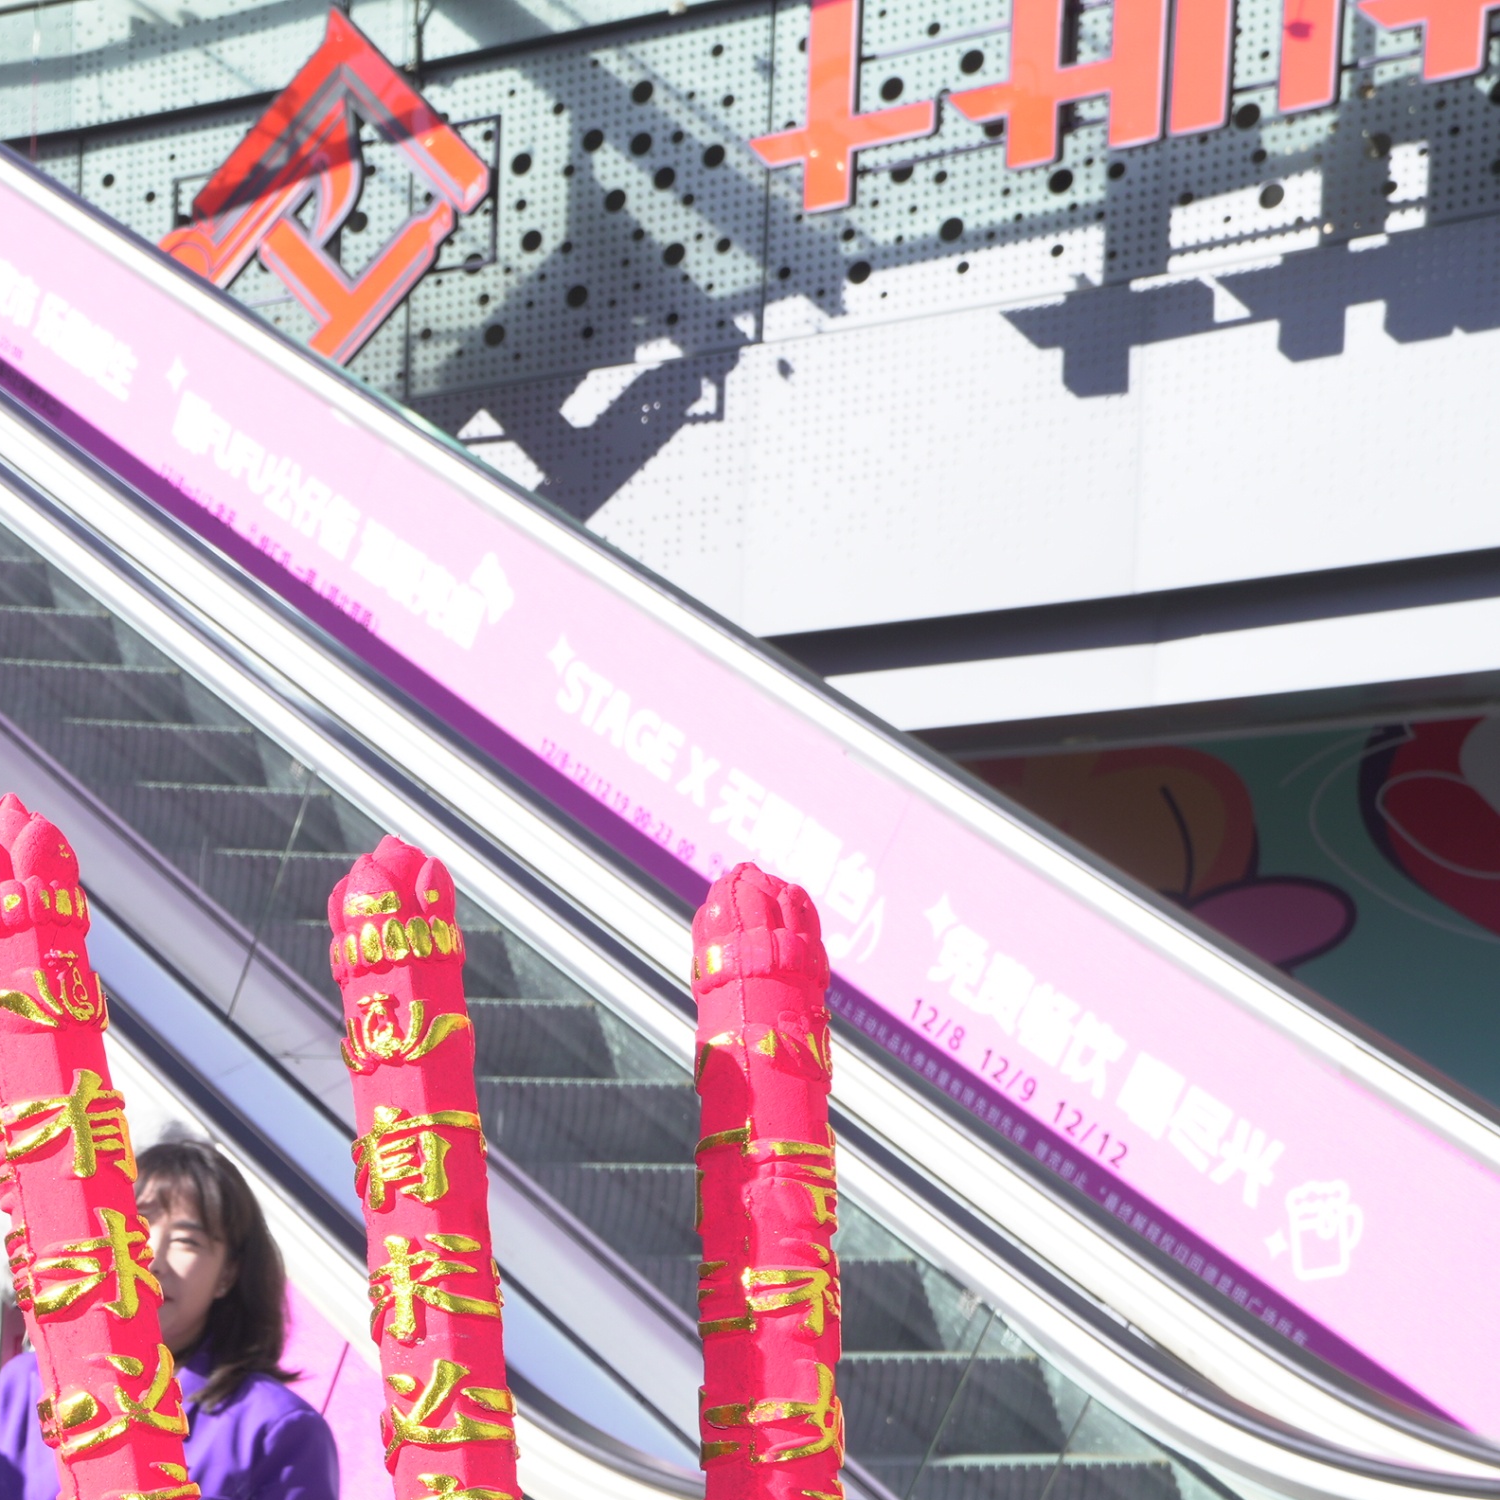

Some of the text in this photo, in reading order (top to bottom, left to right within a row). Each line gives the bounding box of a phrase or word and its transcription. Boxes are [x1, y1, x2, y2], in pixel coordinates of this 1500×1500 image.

[556, 656, 686, 783] STAGE
[675, 742, 721, 807] X
[910, 998, 1130, 1170] 12/8 12/9 12/12
